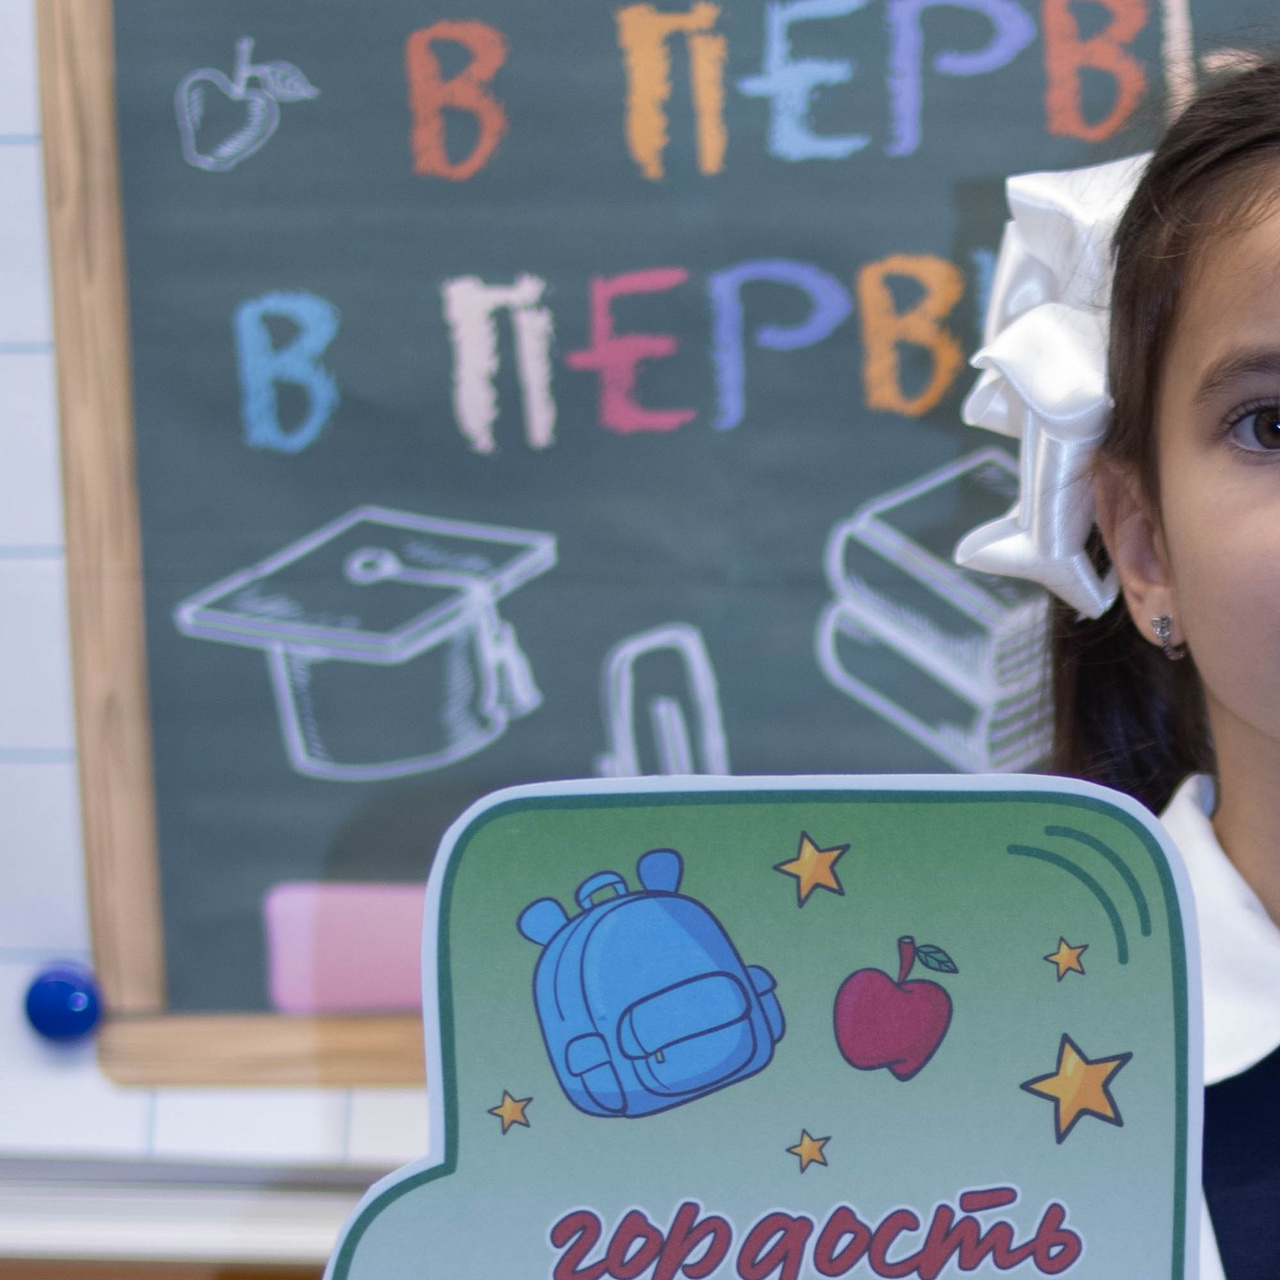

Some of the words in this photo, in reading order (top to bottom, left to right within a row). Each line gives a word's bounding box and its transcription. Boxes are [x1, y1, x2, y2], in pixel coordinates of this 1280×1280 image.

[405, 20, 509, 181] В
[233, 290, 341, 453] В
[441, 249, 998, 456] ПЕРВ
